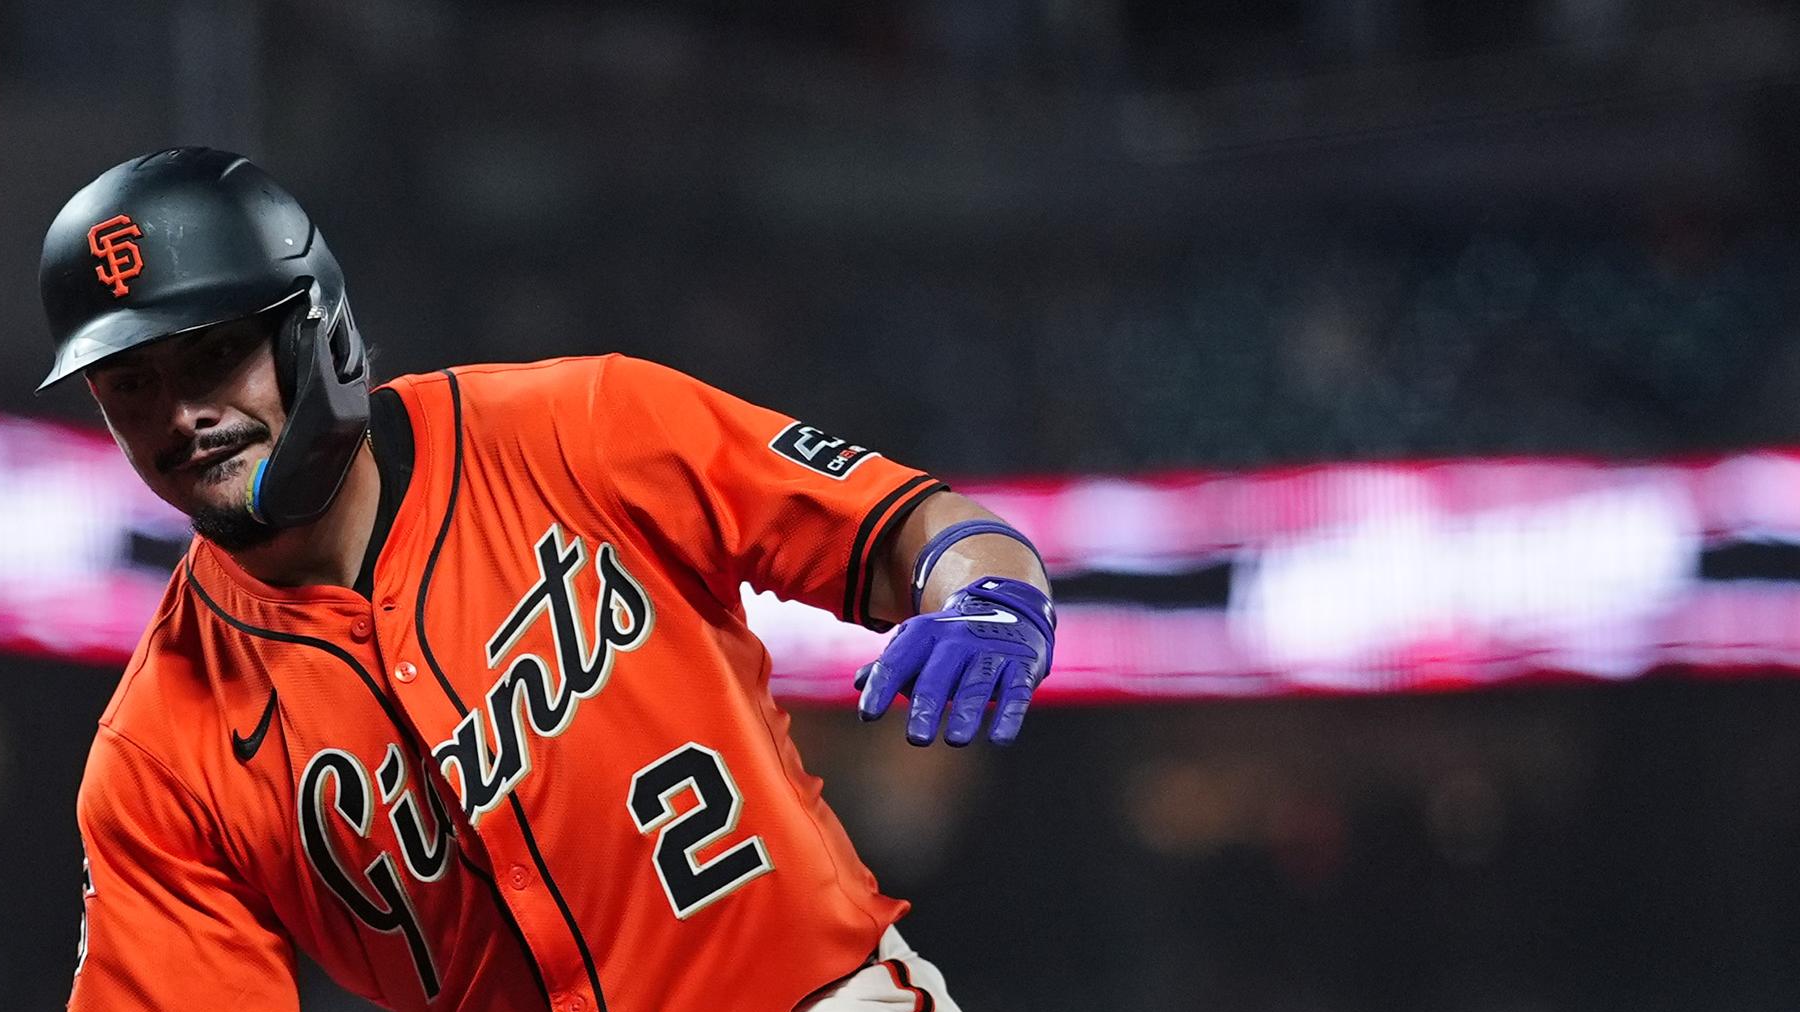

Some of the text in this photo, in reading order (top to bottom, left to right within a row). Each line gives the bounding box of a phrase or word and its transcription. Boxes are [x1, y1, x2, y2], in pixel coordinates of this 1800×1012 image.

[87, 214, 144, 297] SF
[298, 522, 655, 1000] Giants
[626, 741, 774, 919] 2
